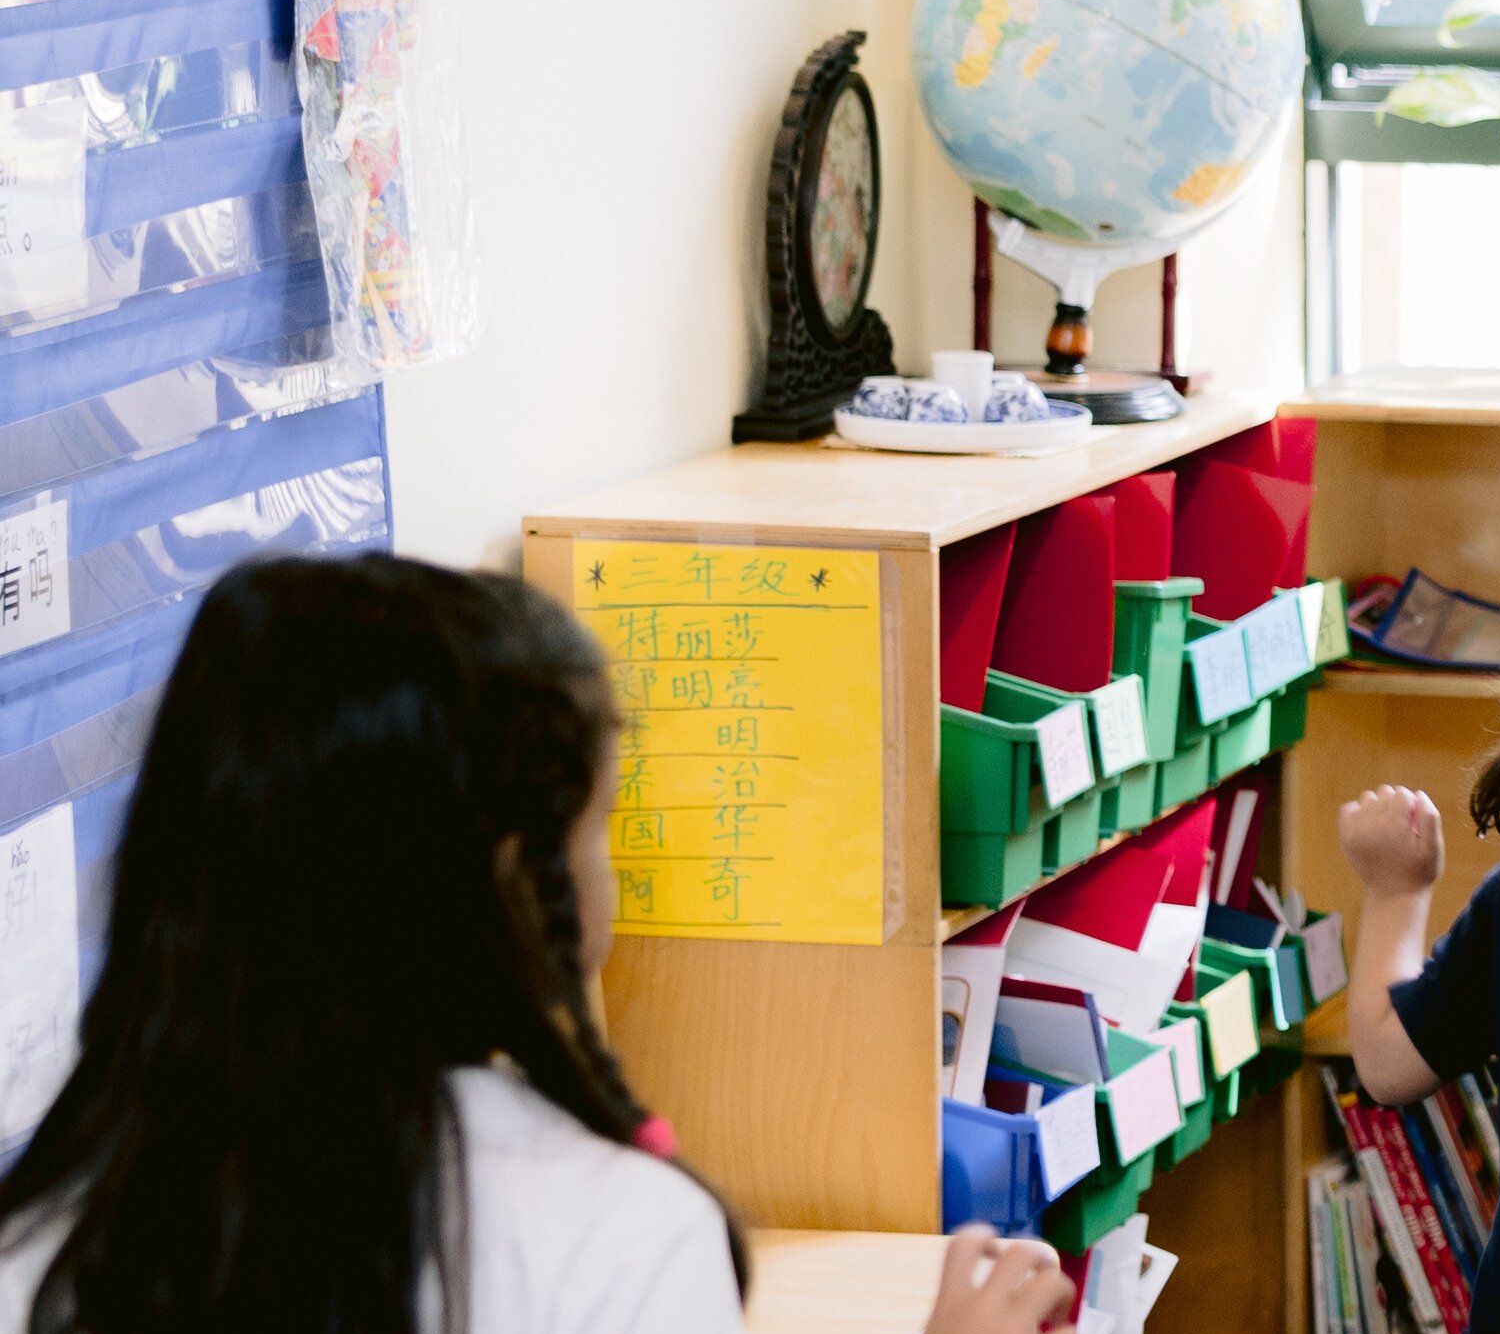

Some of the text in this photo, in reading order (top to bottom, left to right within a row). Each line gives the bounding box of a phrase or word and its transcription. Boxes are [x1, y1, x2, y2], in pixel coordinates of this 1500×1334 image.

[620, 551, 801, 600] 三年级
[616, 610, 765, 661] 特丽莎
